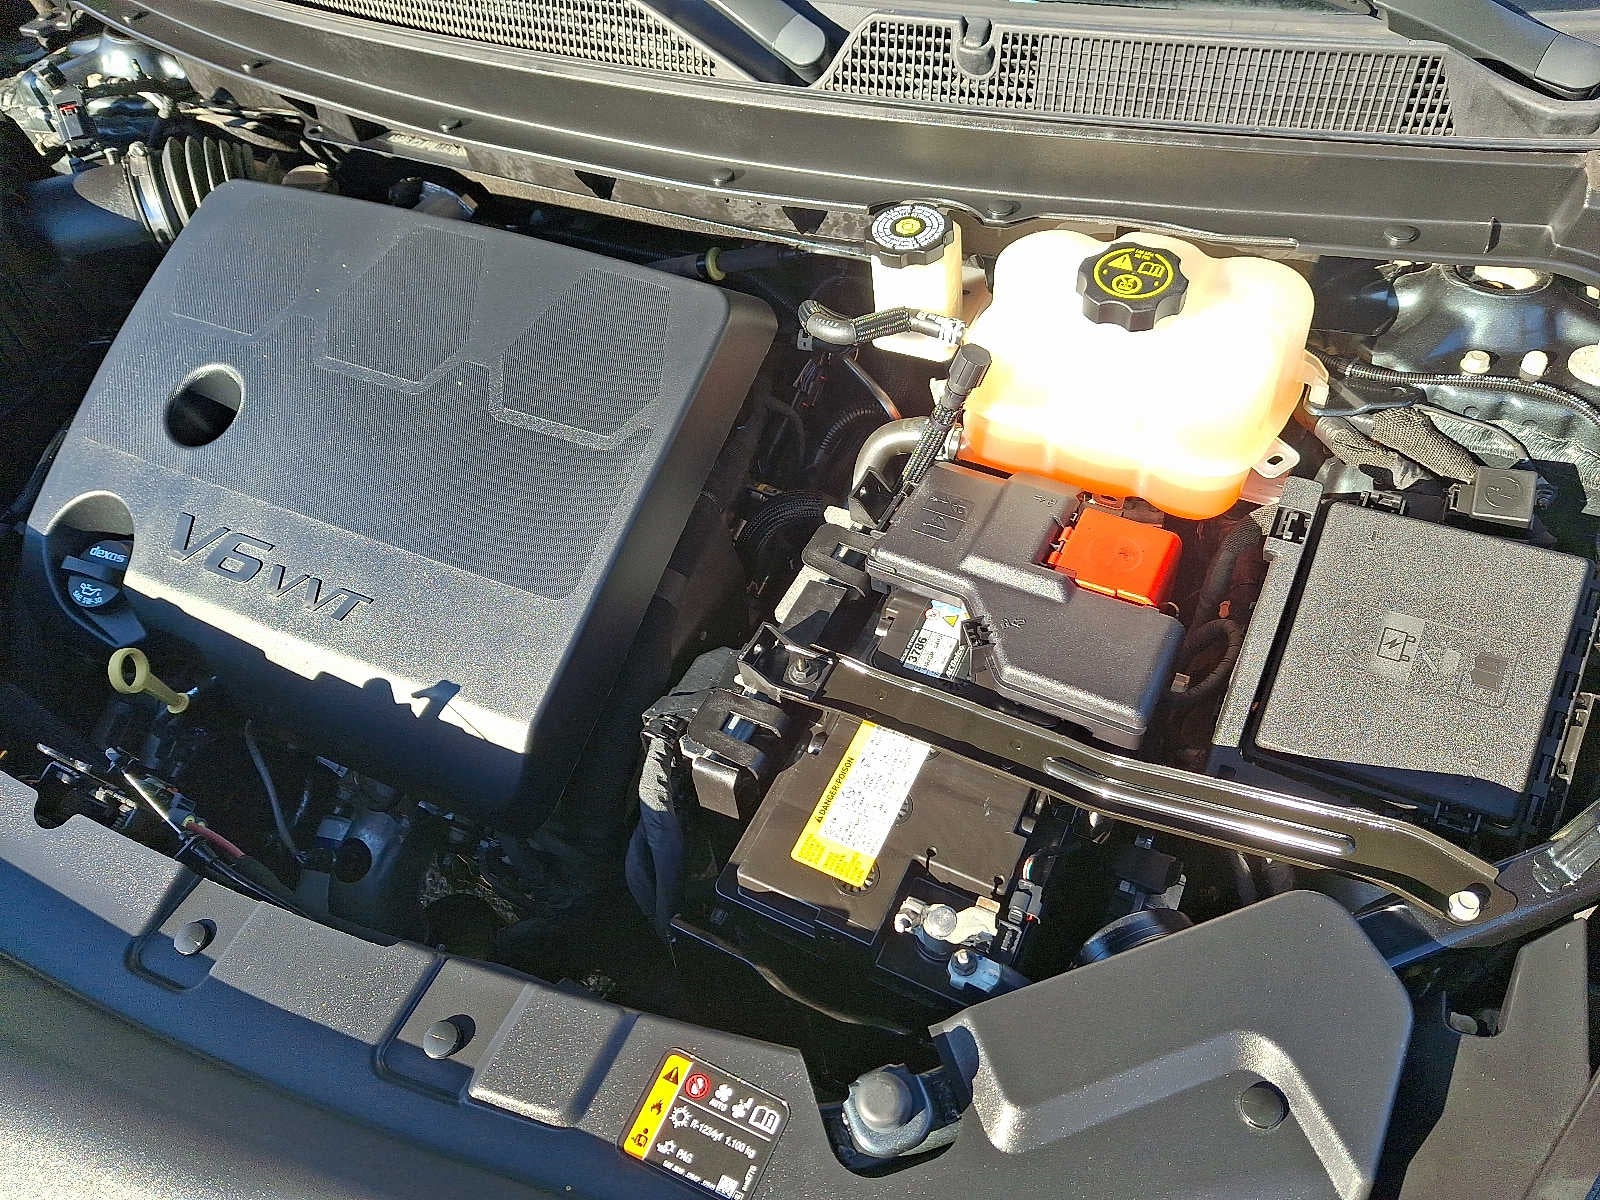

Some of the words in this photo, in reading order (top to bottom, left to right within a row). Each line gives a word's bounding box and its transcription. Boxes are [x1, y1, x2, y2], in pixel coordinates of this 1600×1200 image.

[89, 546, 127, 562] dexos
[171, 512, 276, 583] V6
[265, 563, 375, 621] VVT
[907, 636, 928, 663] 3786
